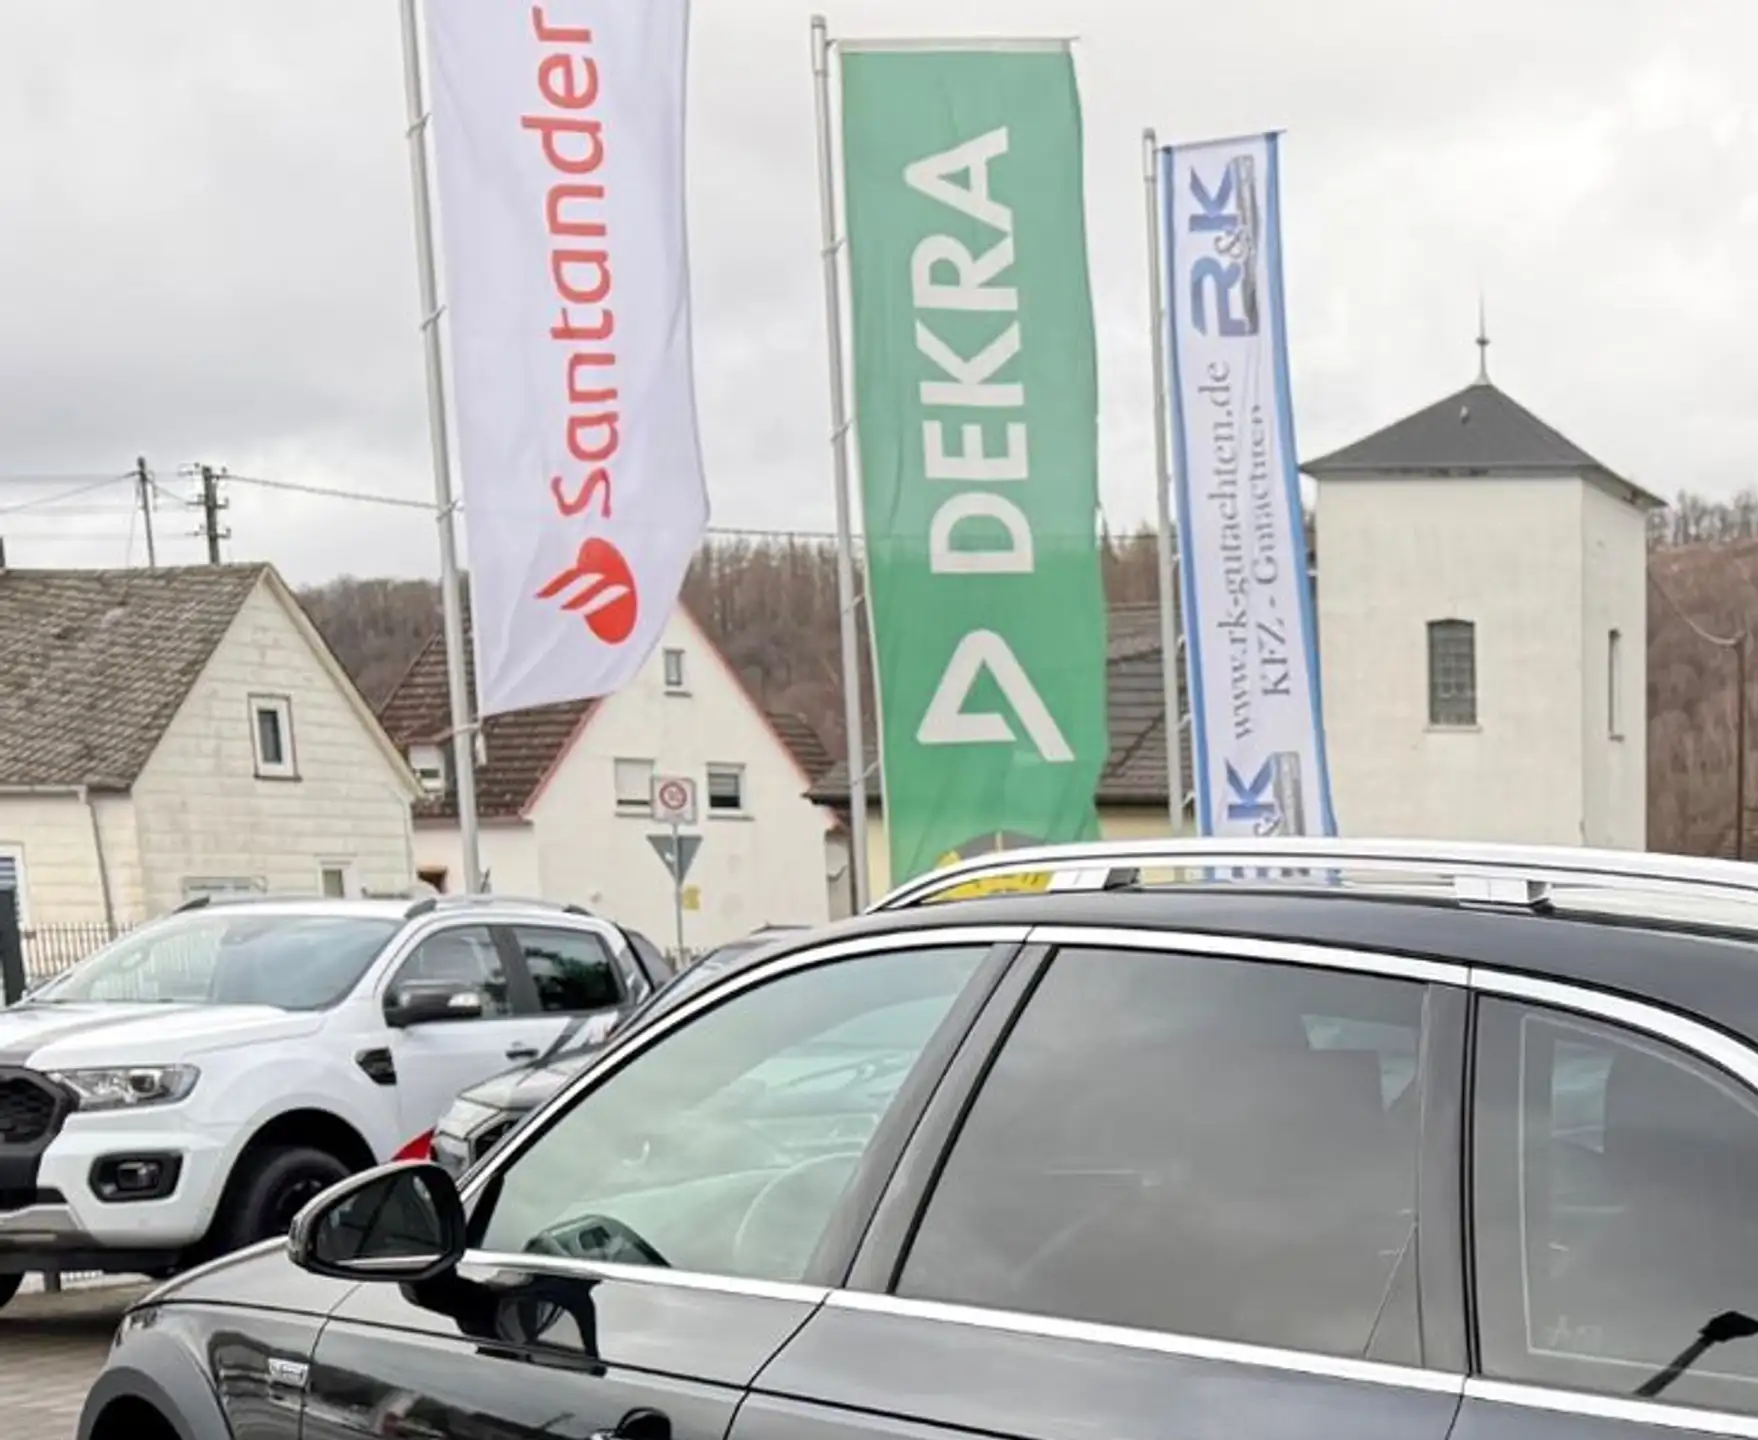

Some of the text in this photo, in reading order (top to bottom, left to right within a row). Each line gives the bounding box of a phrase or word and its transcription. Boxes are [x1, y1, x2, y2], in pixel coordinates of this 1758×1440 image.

[521, 5, 619, 518] Santander
[903, 125, 1034, 574] DEKRA
[1188, 163, 1254, 337] R&K
[1197, 361, 1252, 740] www.rk-gutachten.de
[1256, 617, 1291, 696] KFZ
